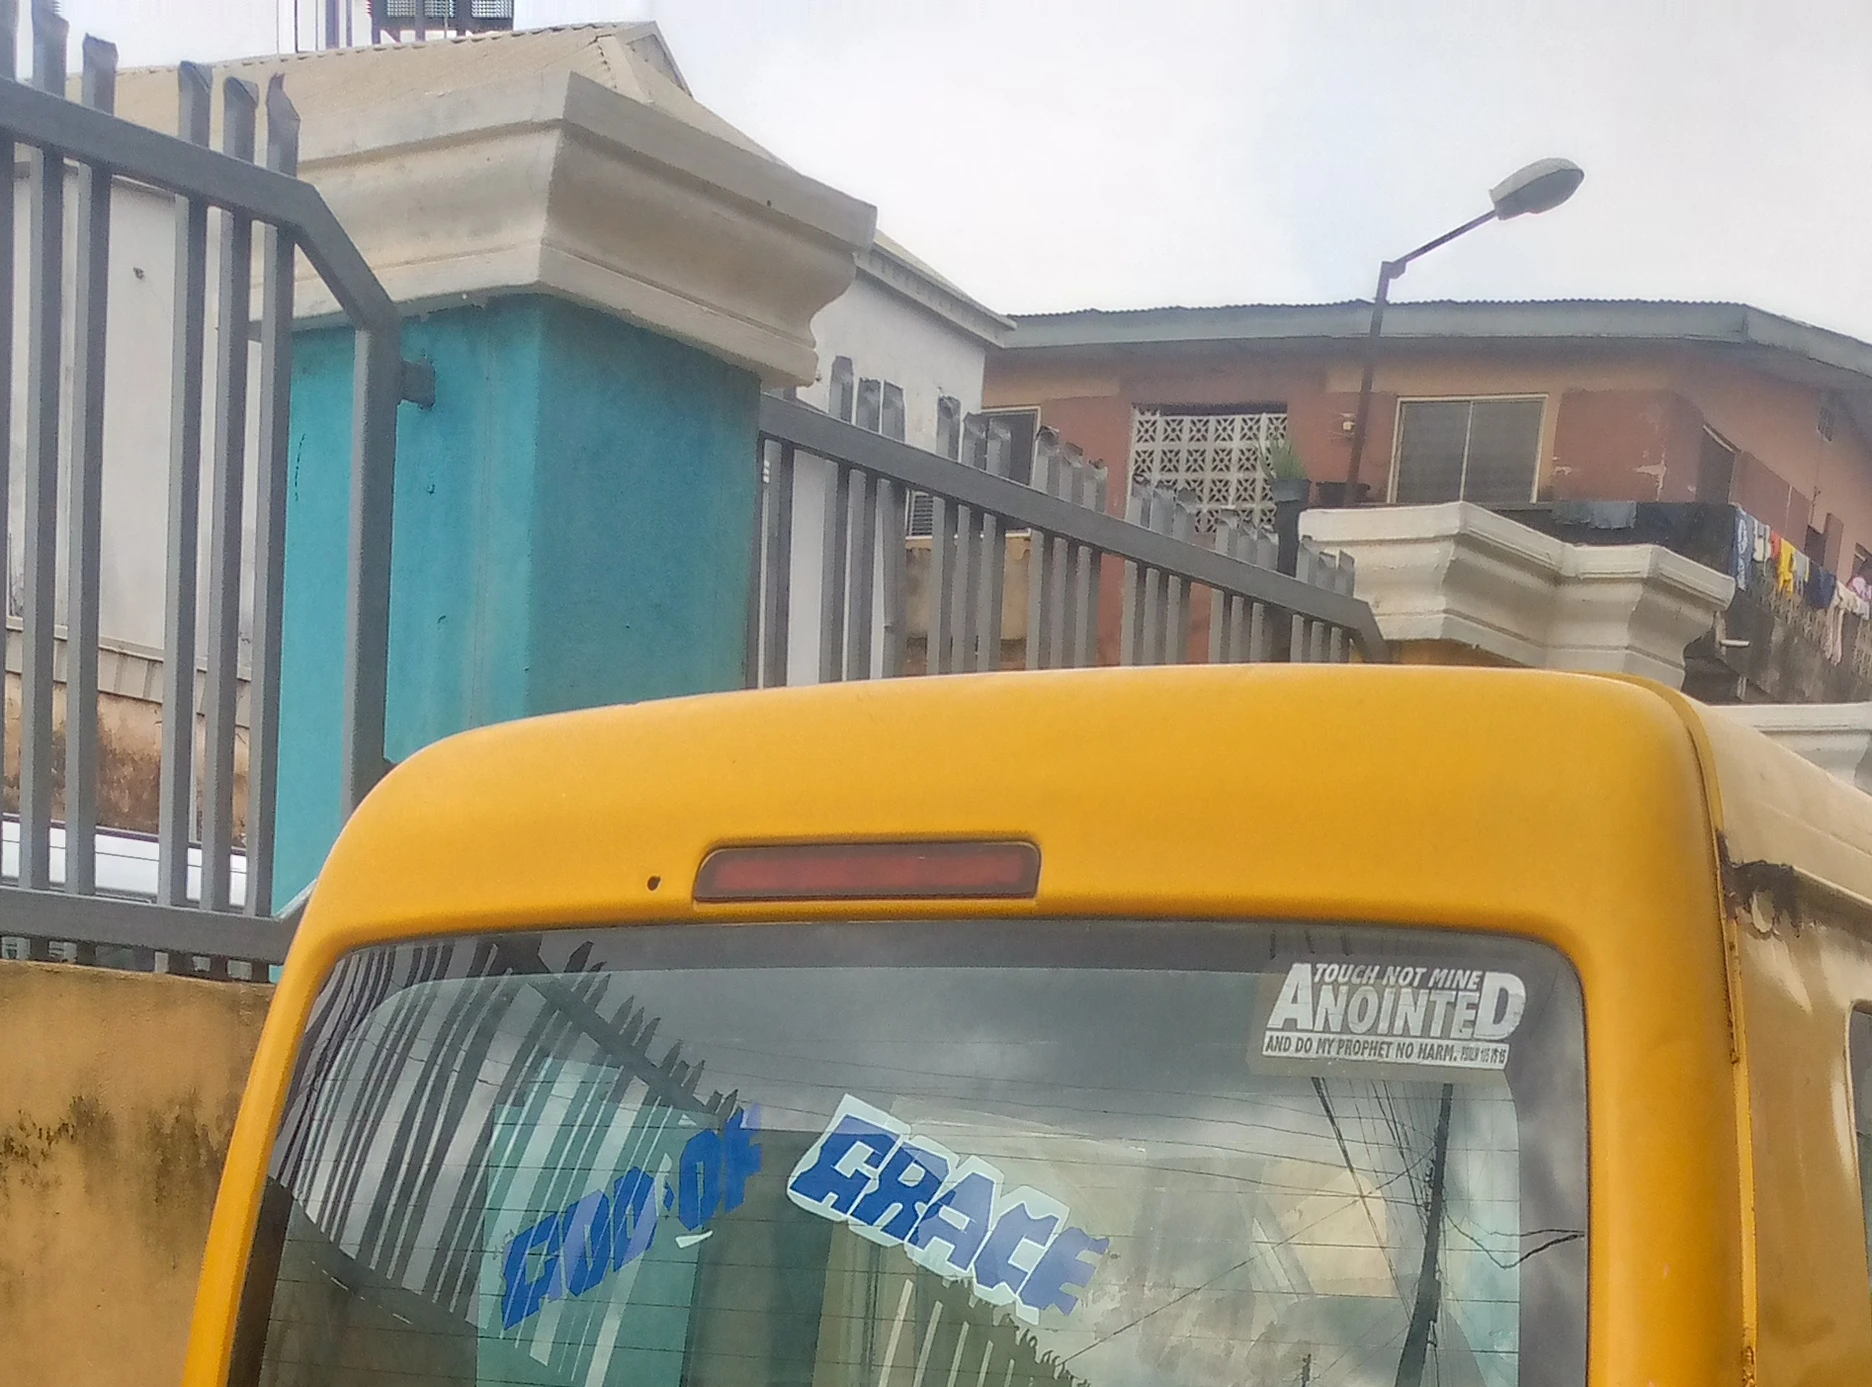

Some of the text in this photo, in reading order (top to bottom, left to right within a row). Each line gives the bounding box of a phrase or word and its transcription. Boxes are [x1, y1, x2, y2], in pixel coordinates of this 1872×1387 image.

[1266, 962, 1527, 1041] ANOINTED
[1313, 963, 1483, 990] TOUCH NOT MINE
[1265, 1035, 1292, 1053] AND
[1294, 1036, 1313, 1053] DO
[1315, 1037, 1336, 1056] MY
[1336, 1039, 1393, 1059] PROPHET
[1395, 1041, 1414, 1060] NO
[788, 1112, 1110, 1318] GRACE
